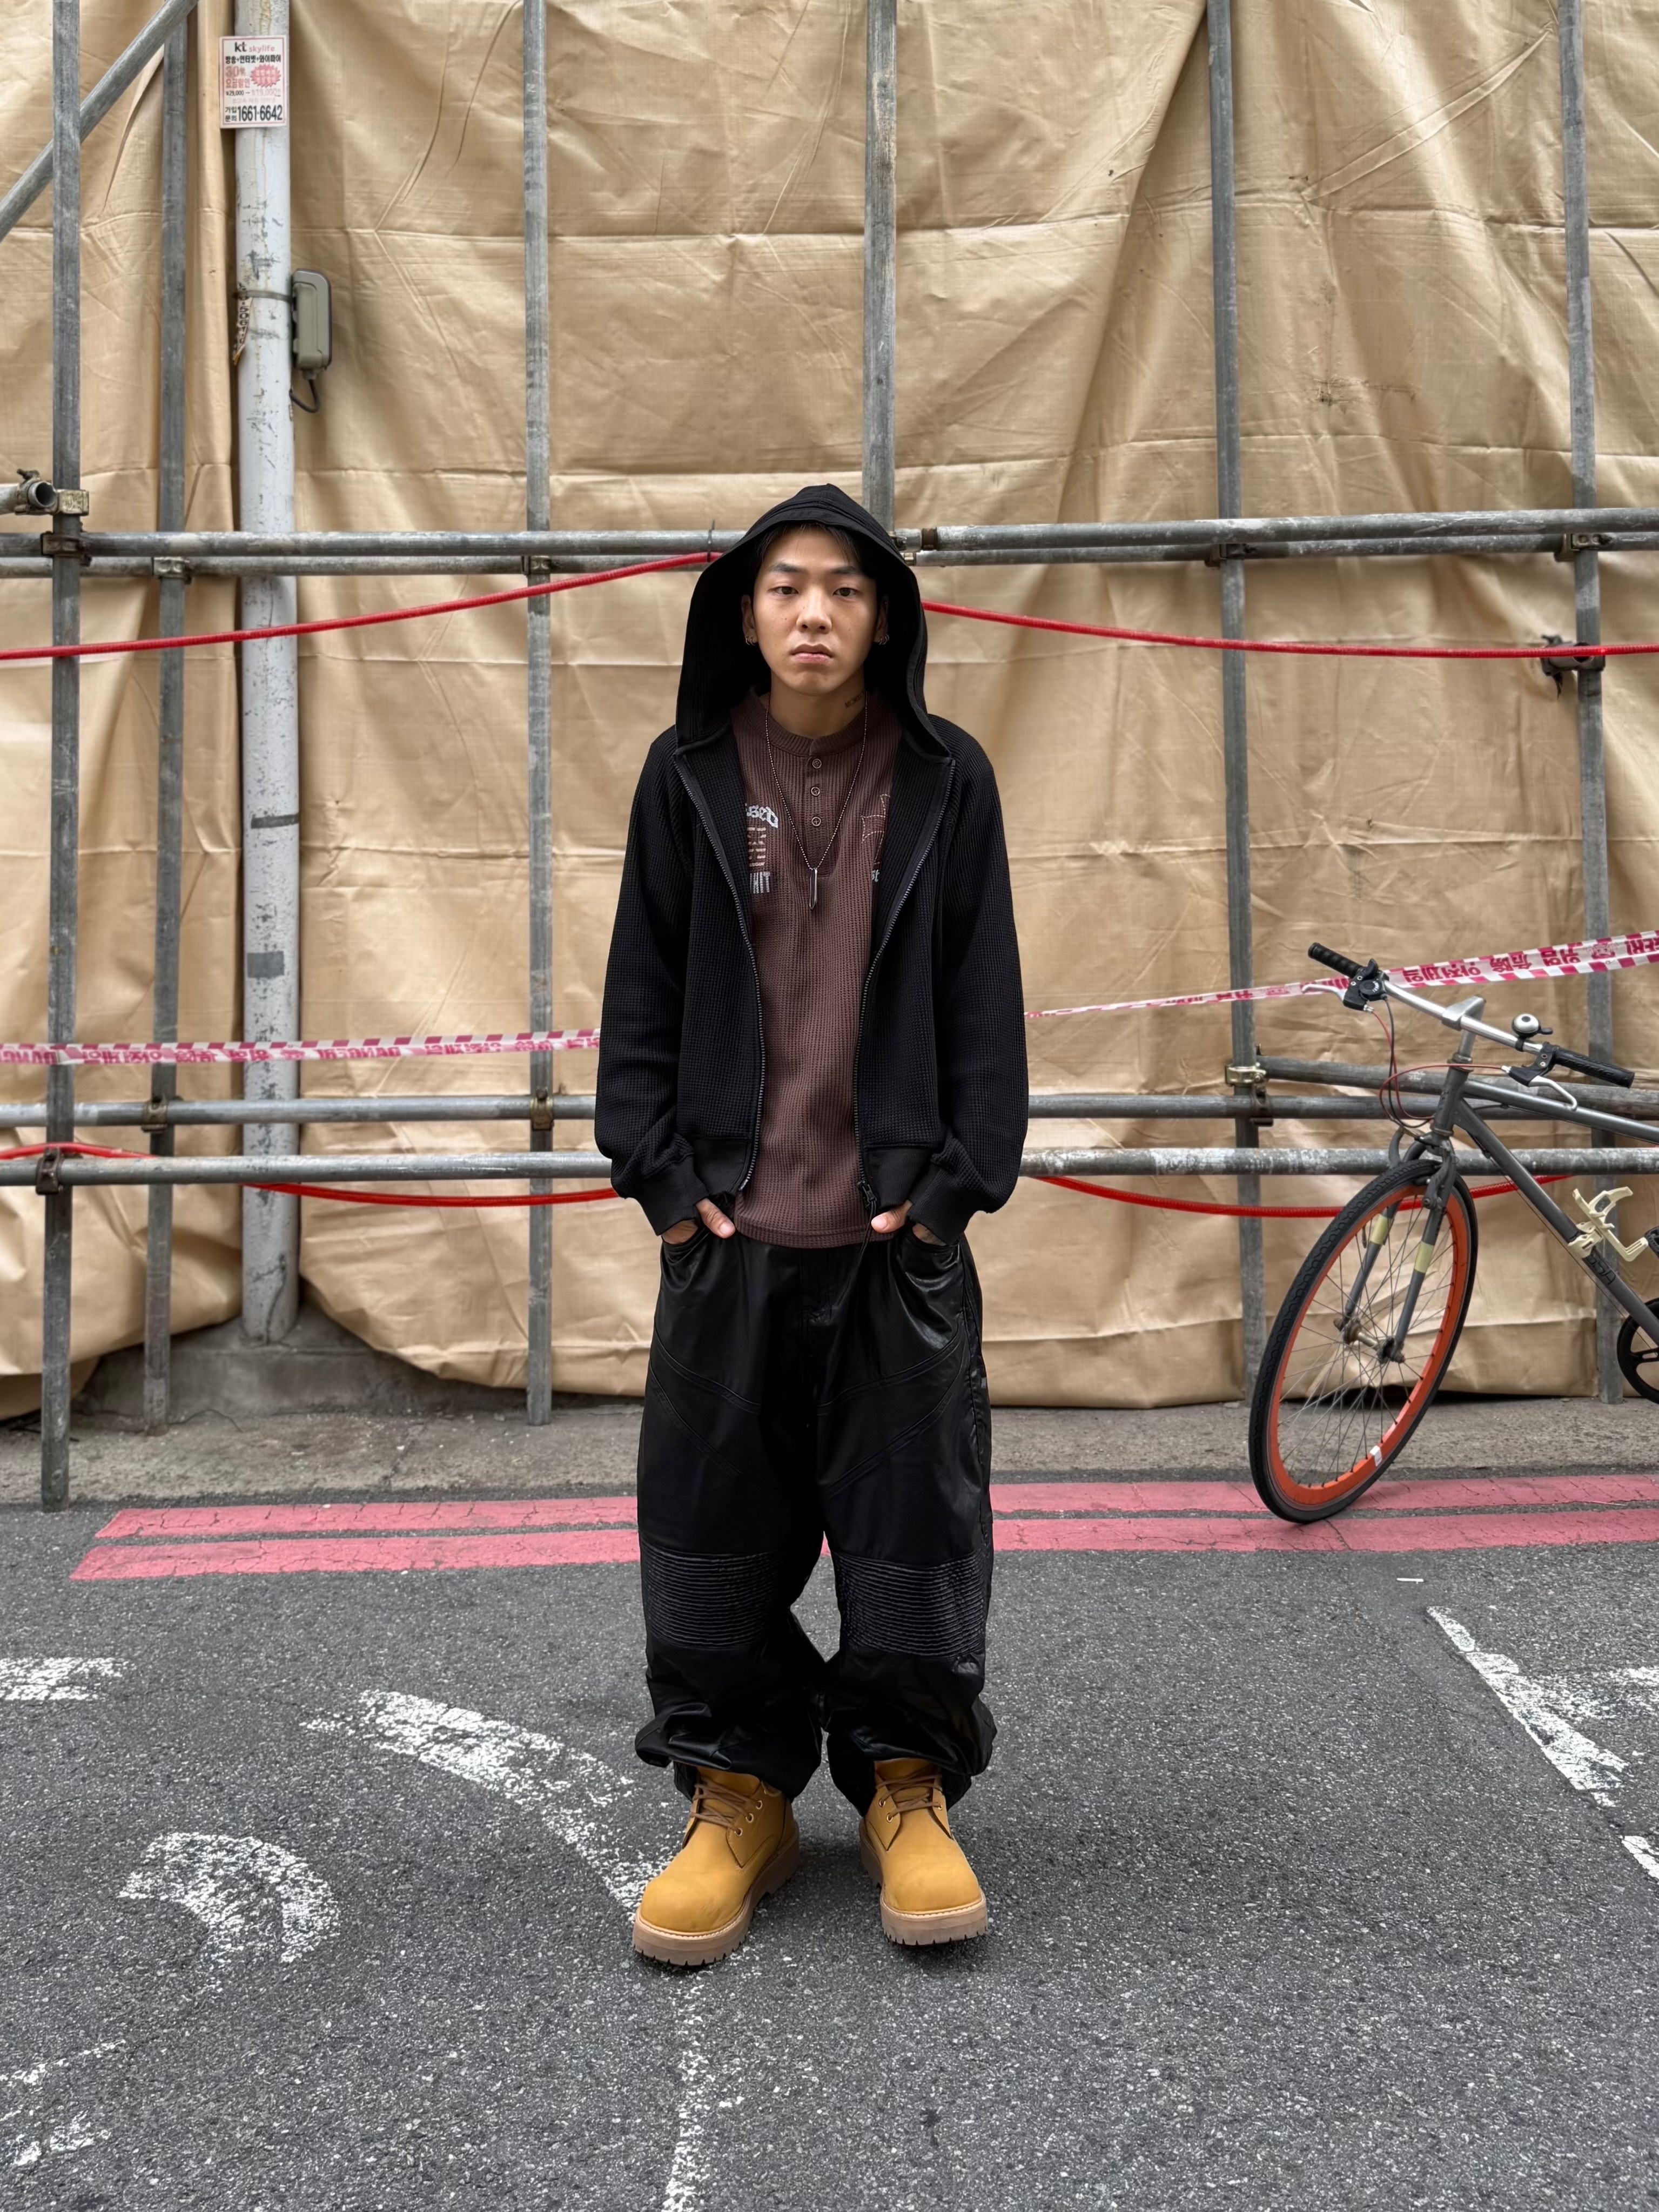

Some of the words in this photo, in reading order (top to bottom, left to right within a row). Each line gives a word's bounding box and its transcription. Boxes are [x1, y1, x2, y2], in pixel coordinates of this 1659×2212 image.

[234, 42, 247, 52] kt
[248, 45, 275, 53] skylife
[1402, 962, 1481, 983] 안전제일
